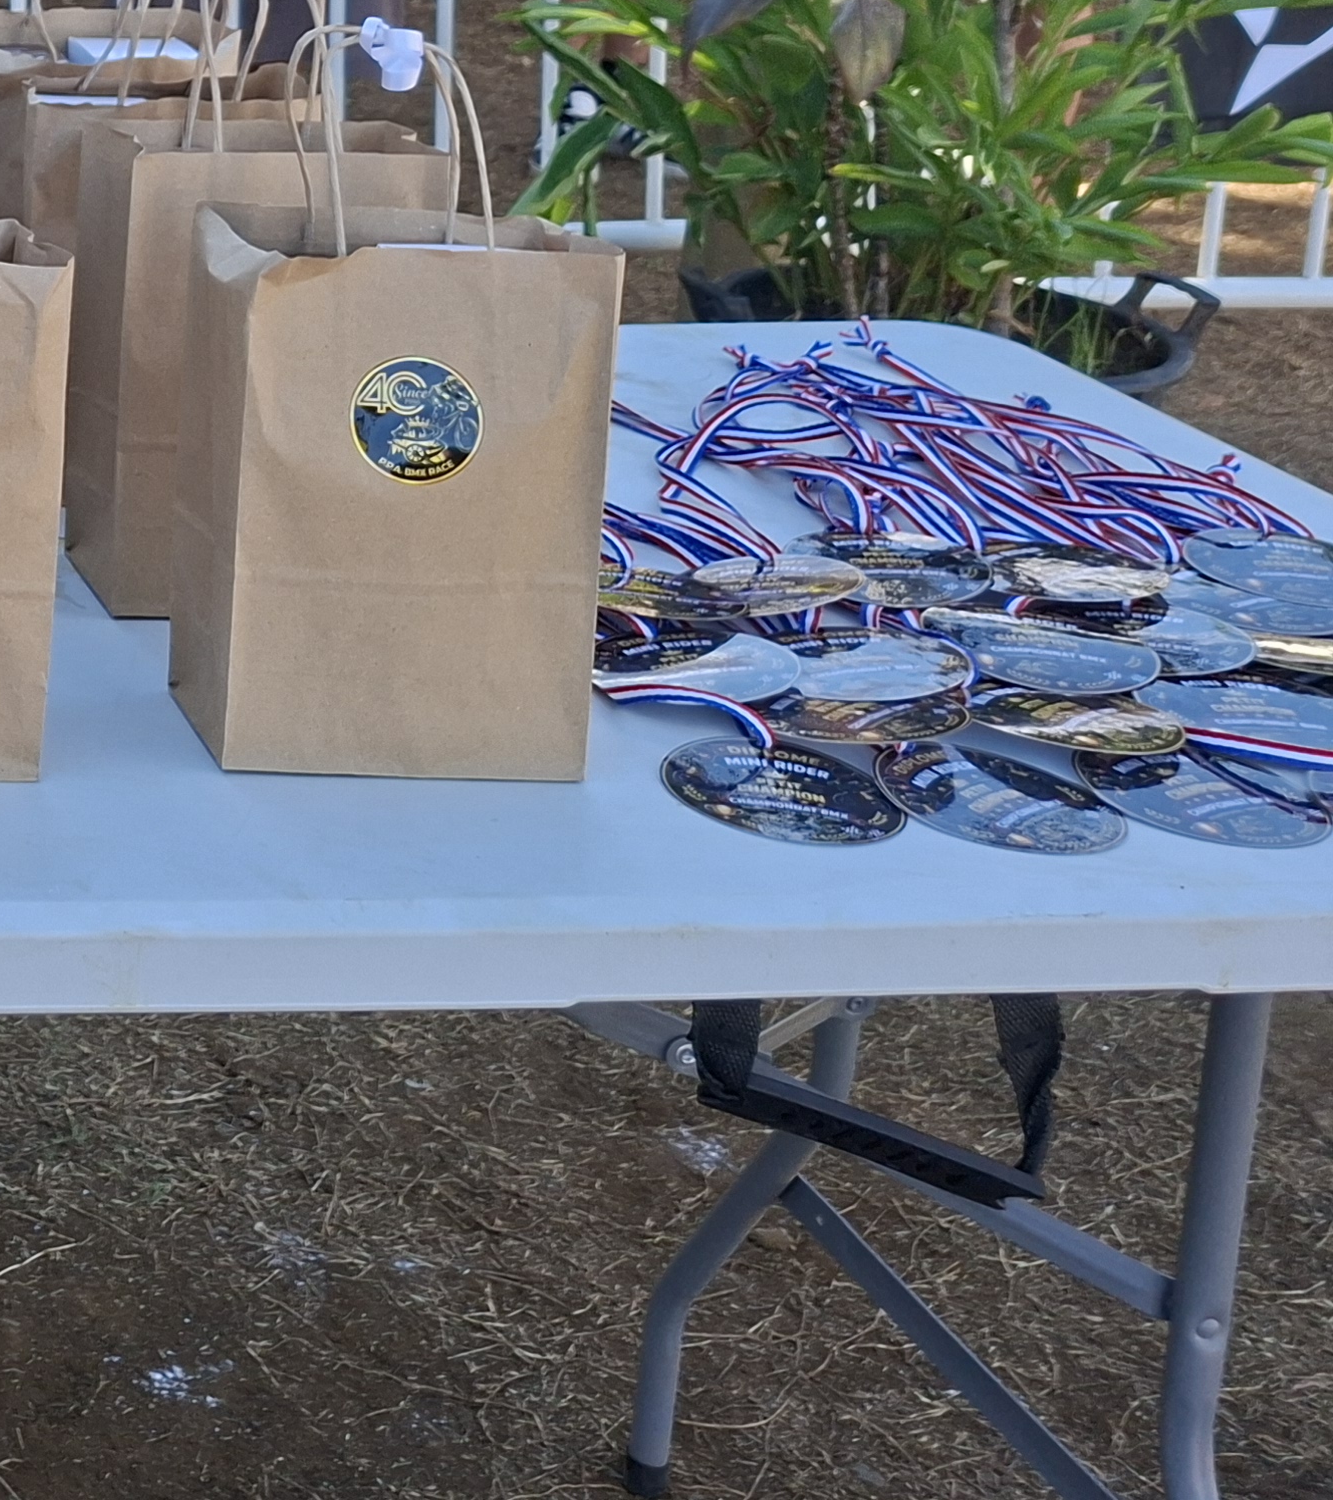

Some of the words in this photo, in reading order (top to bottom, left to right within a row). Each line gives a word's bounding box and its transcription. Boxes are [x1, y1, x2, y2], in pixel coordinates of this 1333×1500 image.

[394, 383, 429, 399] Since
[404, 467, 427, 477] BMX
[428, 459, 455, 476] RACE
[724, 757, 768, 767] MINI
[774, 760, 830, 779] RIDER
